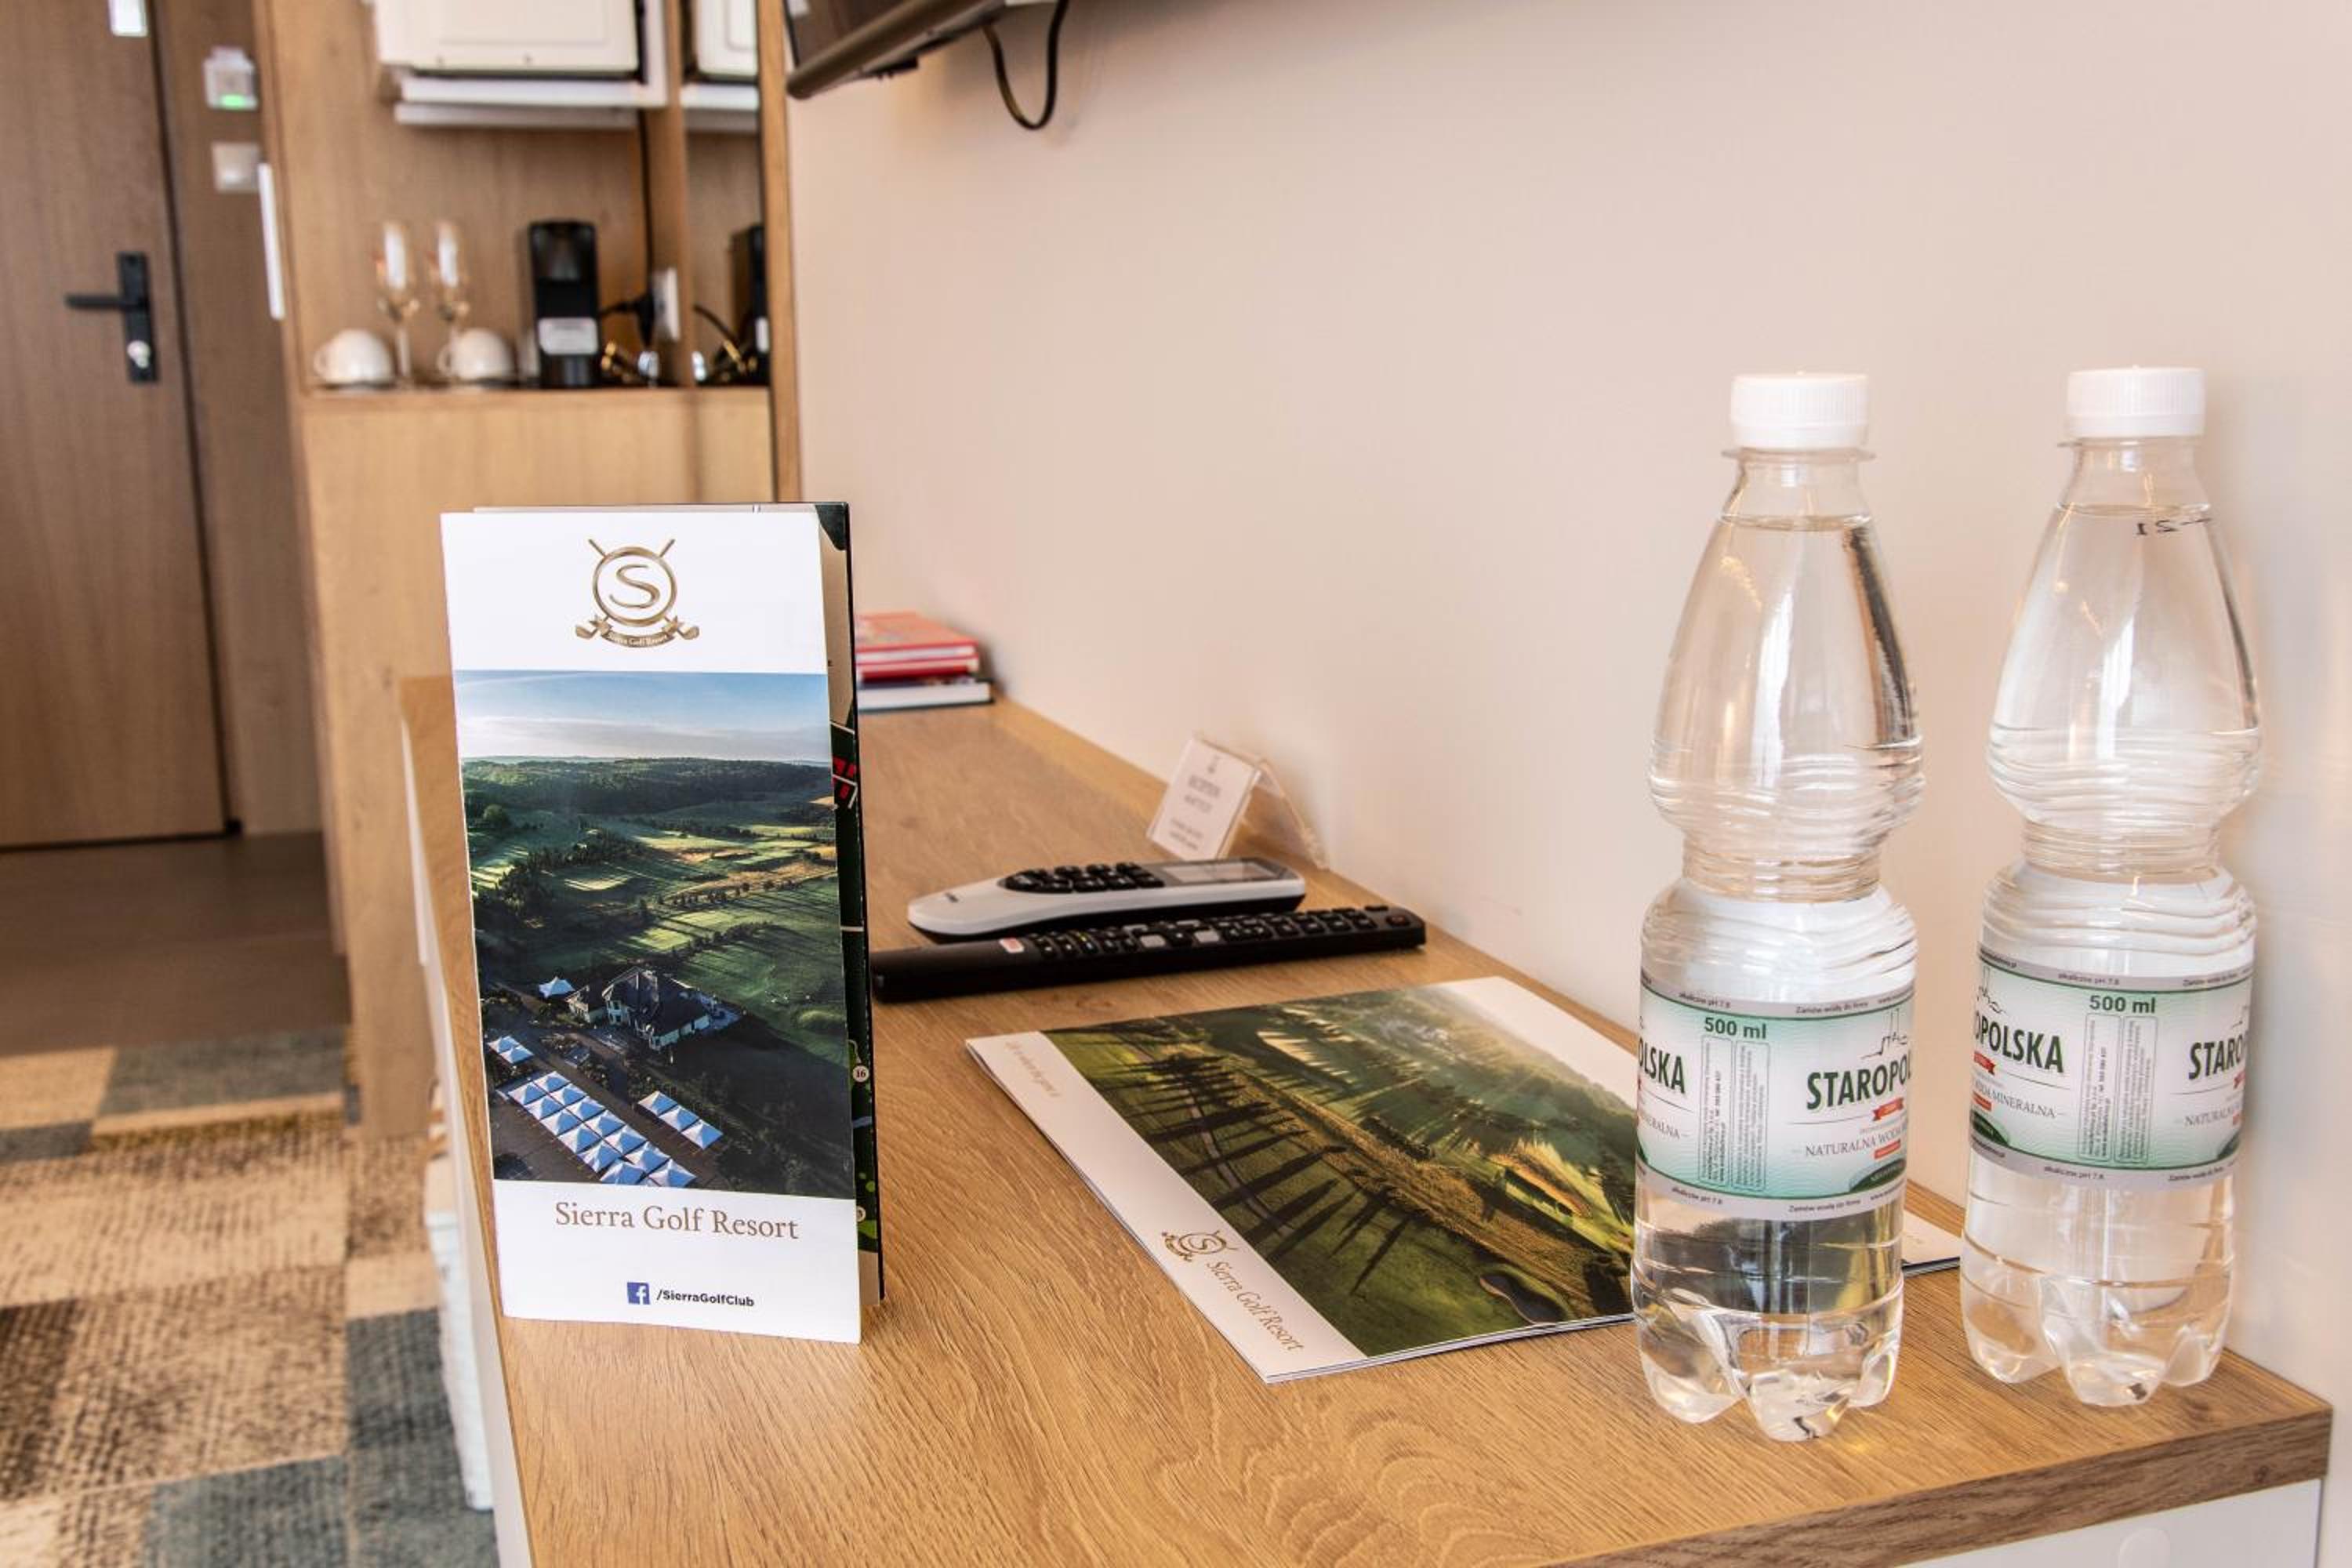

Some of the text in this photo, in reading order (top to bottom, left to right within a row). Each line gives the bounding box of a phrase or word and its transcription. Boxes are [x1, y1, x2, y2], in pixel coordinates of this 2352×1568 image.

[2089, 995, 2156, 1014] 500 ml
[1704, 1017, 1767, 1040] 500 ml
[555, 1201, 799, 1240] Sierra Golf Resort
[656, 1288, 755, 1308] /SierraGolfClub
[1207, 1261, 1305, 1351] Sierra Golf Resort
